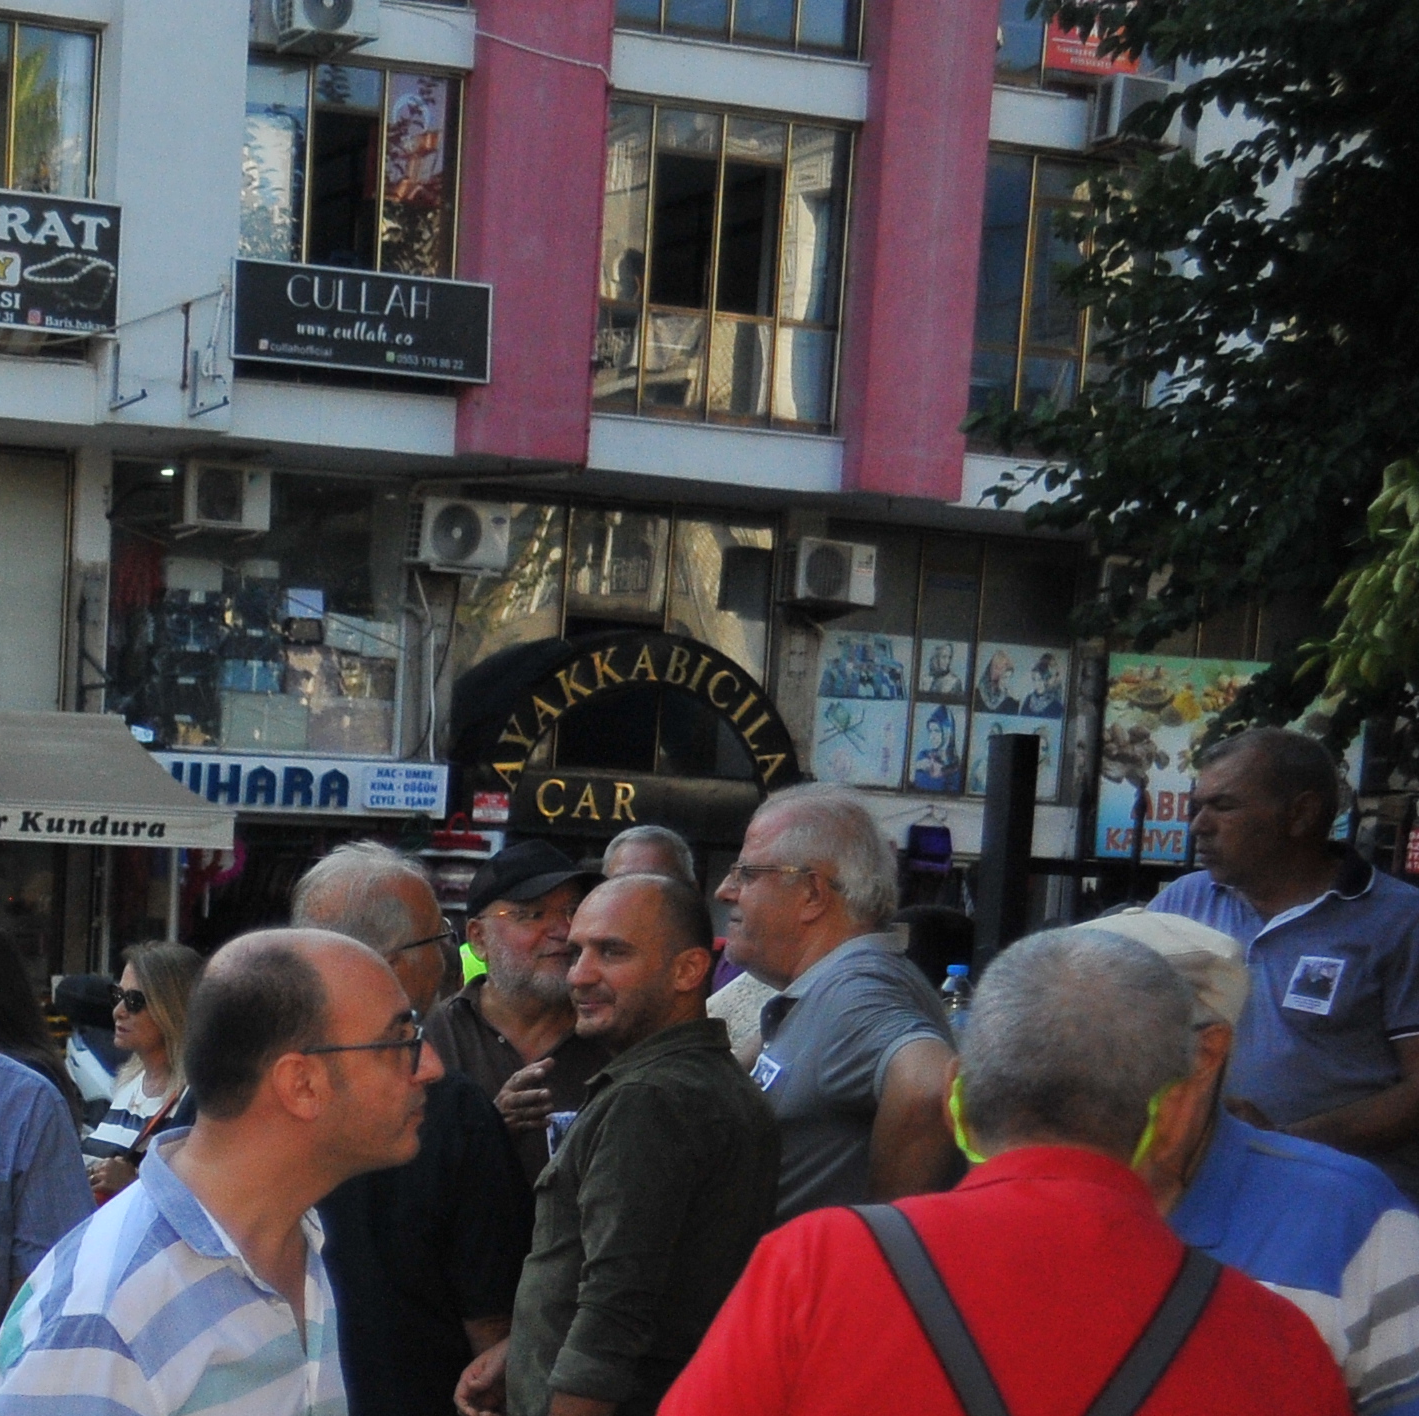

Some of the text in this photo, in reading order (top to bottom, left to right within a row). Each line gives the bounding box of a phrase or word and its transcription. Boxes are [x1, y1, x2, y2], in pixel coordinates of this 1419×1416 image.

[286, 274, 431, 320] CULLAH
[18, 810, 166, 838] Kundura
[535, 778, 636, 824] ÇAR
